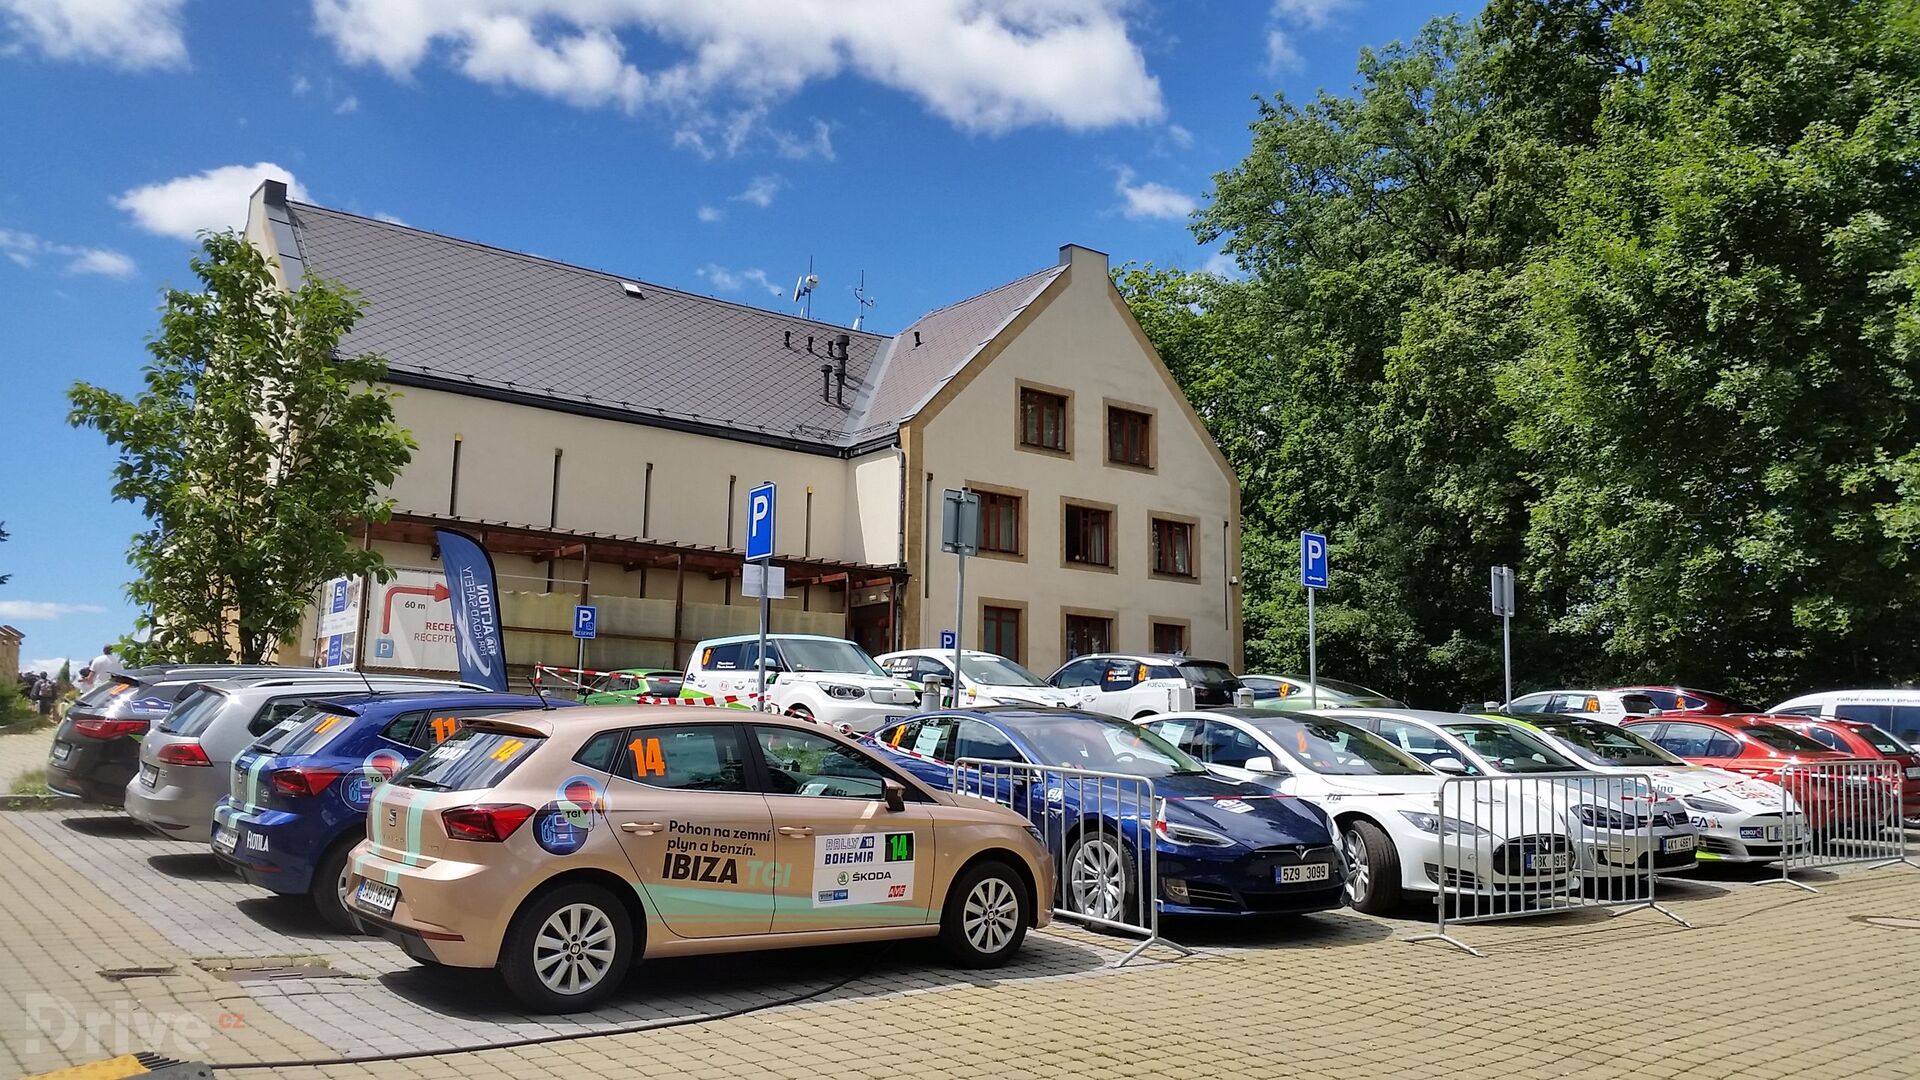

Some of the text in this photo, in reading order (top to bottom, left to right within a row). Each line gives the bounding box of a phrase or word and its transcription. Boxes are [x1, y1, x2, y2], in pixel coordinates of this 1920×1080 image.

[751, 495, 768, 537] P
[1308, 539, 1322, 570] P
[404, 600, 416, 609] 60
[578, 609, 592, 629] P
[943, 634, 953, 648] P
[702, 649, 711, 666] 6
[1138, 665, 1148, 681] 3
[1279, 683, 1289, 697] 9
[1587, 699, 1599, 711] 15
[313, 716, 342, 734] 11
[430, 717, 456, 743] 11
[490, 740, 525, 762] 14
[628, 737, 667, 777] 14
[565, 810, 581, 819] TGI
[668, 820, 771, 843] Pohon na zemní
[246, 830, 269, 852] FLOTILA
[667, 837, 757, 857] plyn a benzín.
[825, 837, 860, 850] RALLY
[890, 834, 908, 860] 14
[824, 851, 874, 865] BOHEMIA
[1551, 854, 1566, 867] 915
[661, 852, 793, 888] IBIZA TGI
[852, 871, 892, 882] ŠKODA
[1283, 865, 1326, 881] 5Z9 3099
[888, 885, 906, 898] AVE
